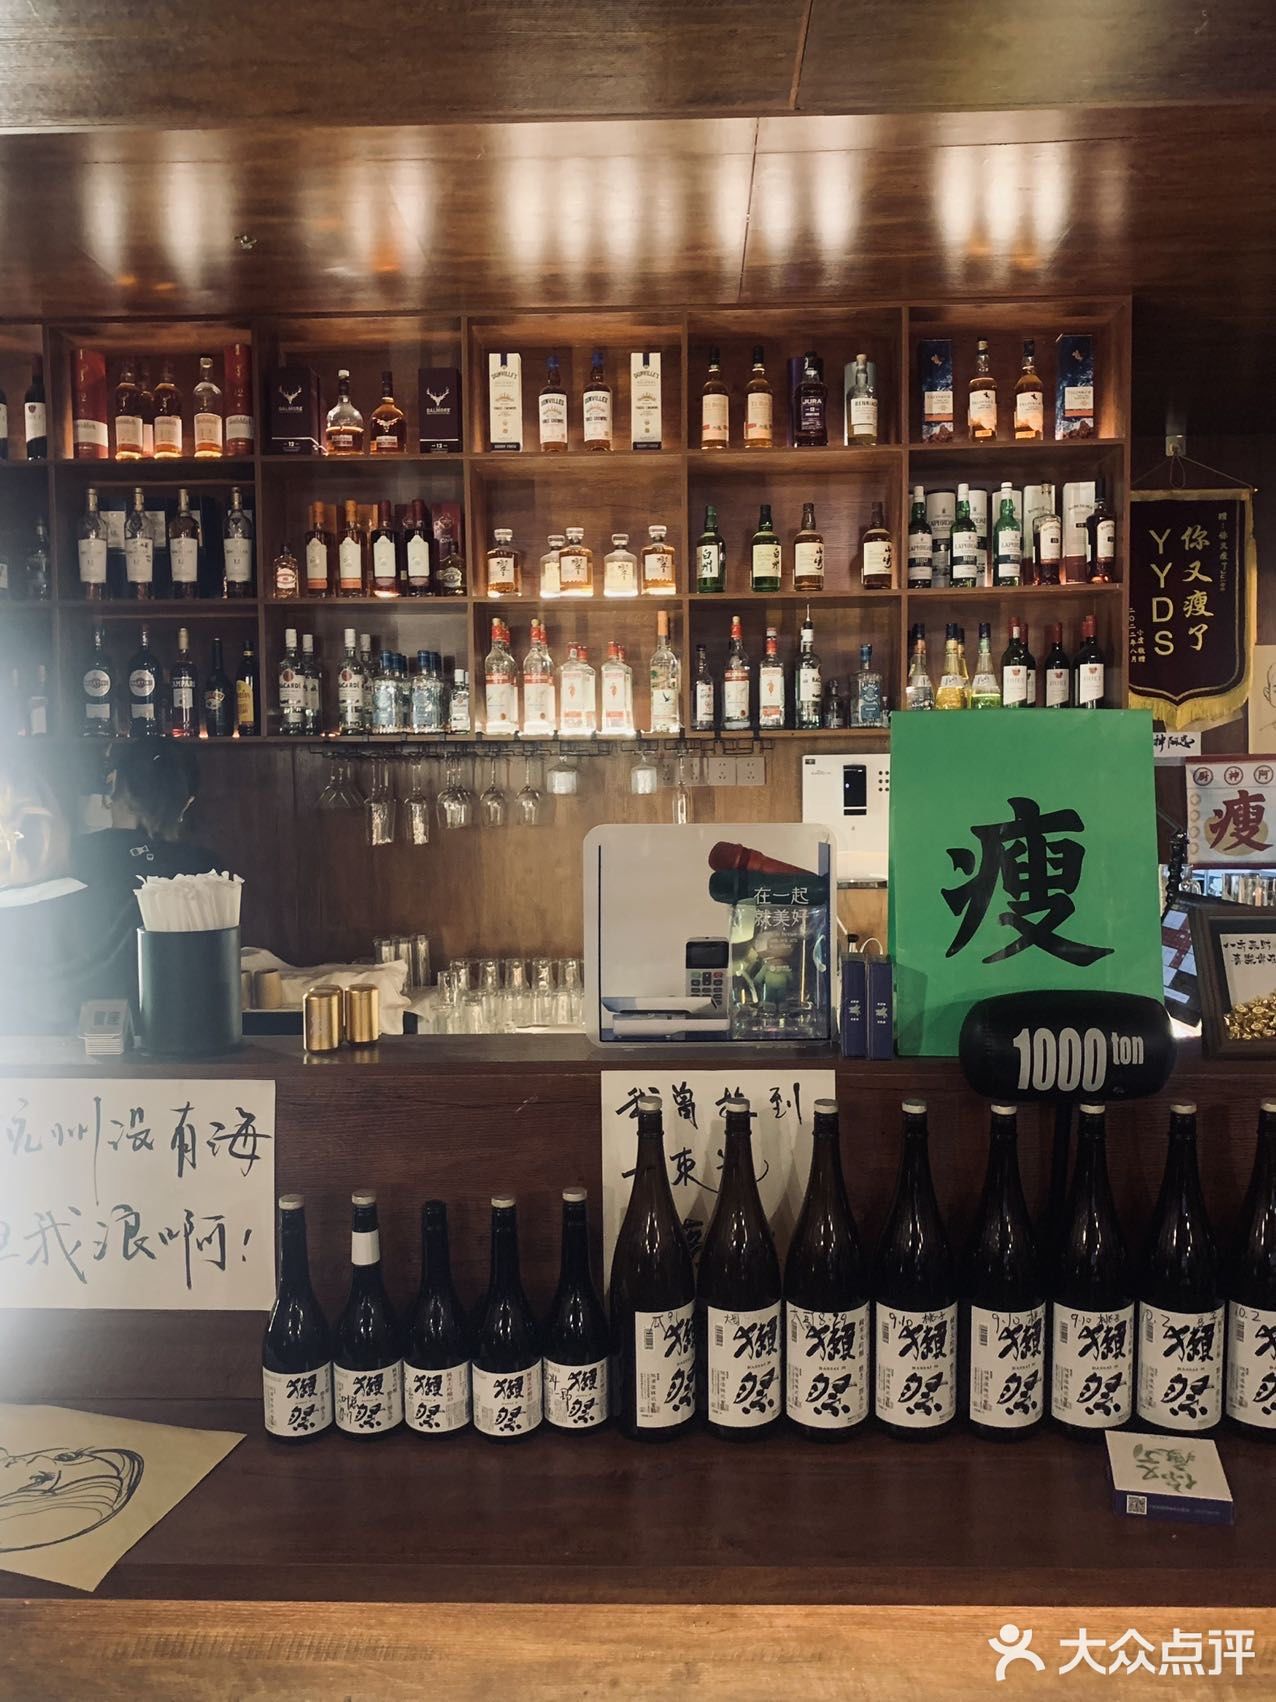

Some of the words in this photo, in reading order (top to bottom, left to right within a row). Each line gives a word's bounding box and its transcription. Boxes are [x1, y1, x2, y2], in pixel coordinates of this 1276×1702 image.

[702, 549, 713, 573] 白州
[1149, 528, 1175, 656] YYDS
[1180, 524, 1215, 651] 你又瘦了
[1209, 789, 1274, 852] 瘦
[754, 885, 809, 905] 在一起
[940, 796, 1115, 967] 瘦
[755, 908, 809, 927] 就美好
[1012, 1027, 1108, 1093] 1000
[1111, 1031, 1144, 1065] ton
